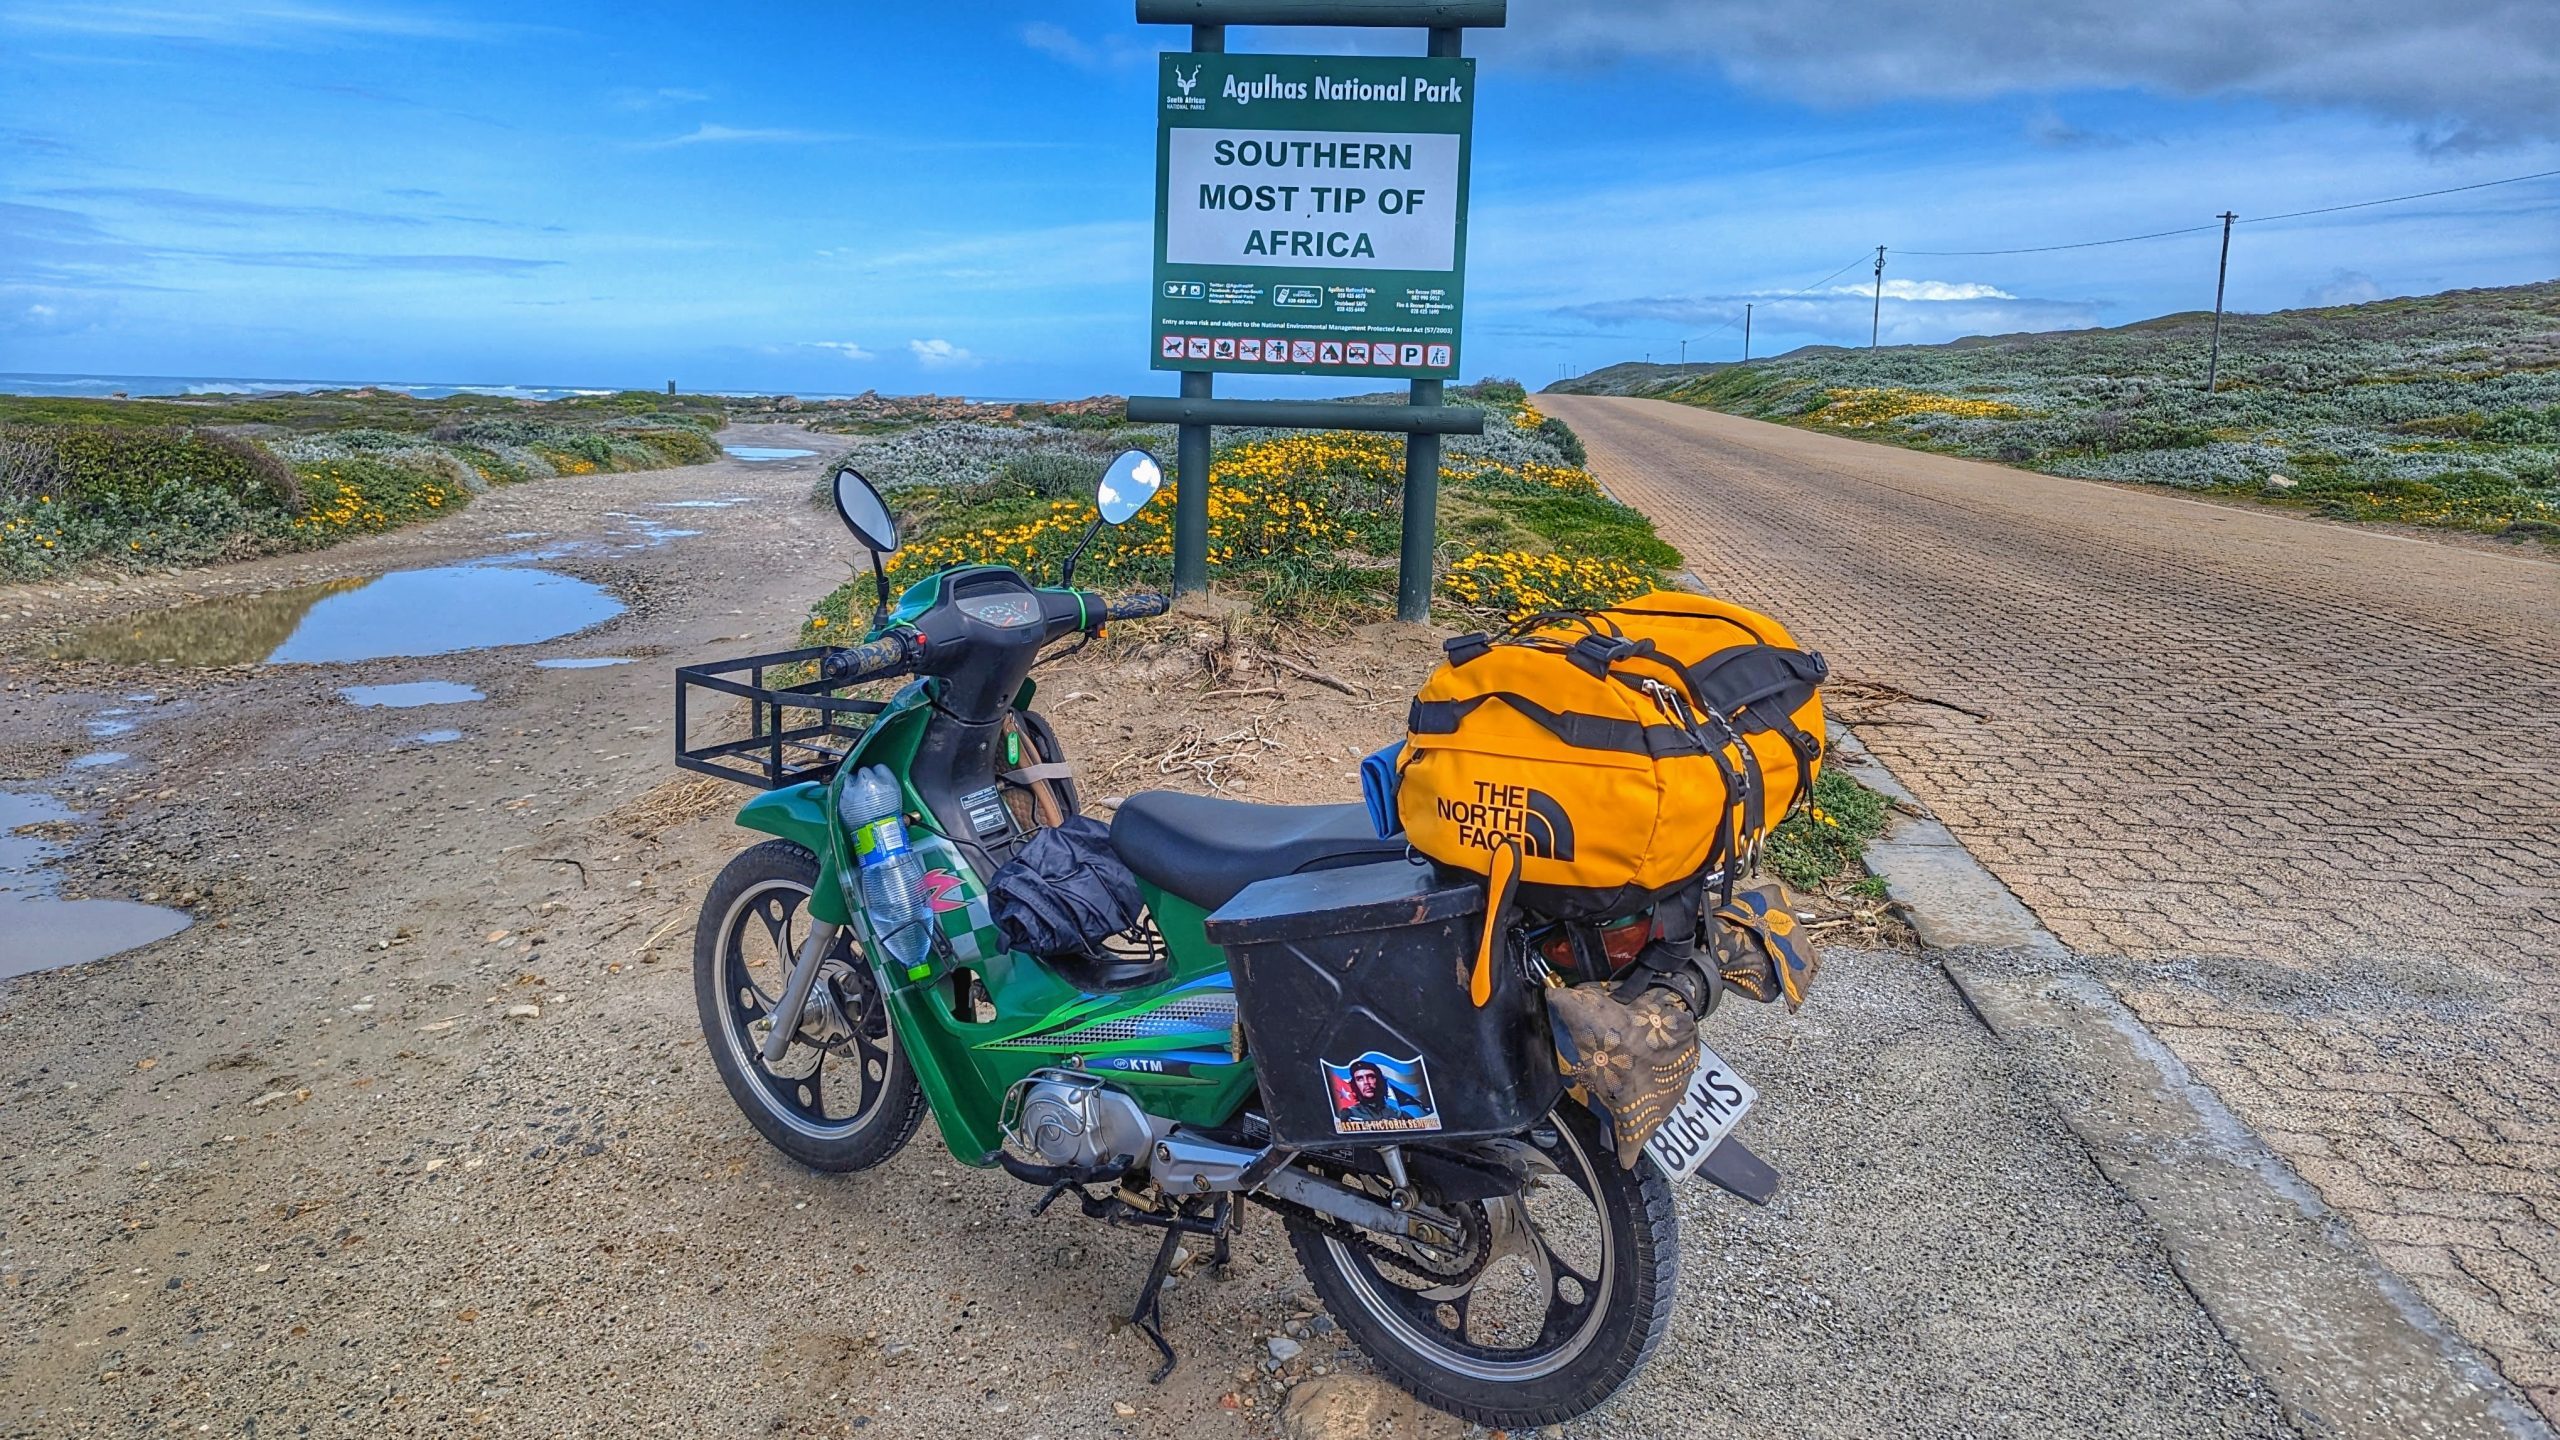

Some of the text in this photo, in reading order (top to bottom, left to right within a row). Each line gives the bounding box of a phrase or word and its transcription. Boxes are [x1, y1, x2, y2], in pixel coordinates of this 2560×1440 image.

[1184, 96, 1206, 104] African
[1222, 73, 1462, 105] Agulhas National Park
[1214, 139, 1412, 170] SOUTHERN
[1199, 183, 1425, 215] MOST TIP OF
[1243, 229, 1375, 258] AFRICA
[1328, 324, 1367, 332] Management
[1424, 326, 1453, 334] (57/2003)
[1405, 347, 1418, 363] P
[1473, 780, 1525, 810] THE
[1437, 797, 1524, 833] NORTH
[1129, 1059, 1163, 1072] KTM
[1371, 1118, 1408, 1131] VICTORIA
